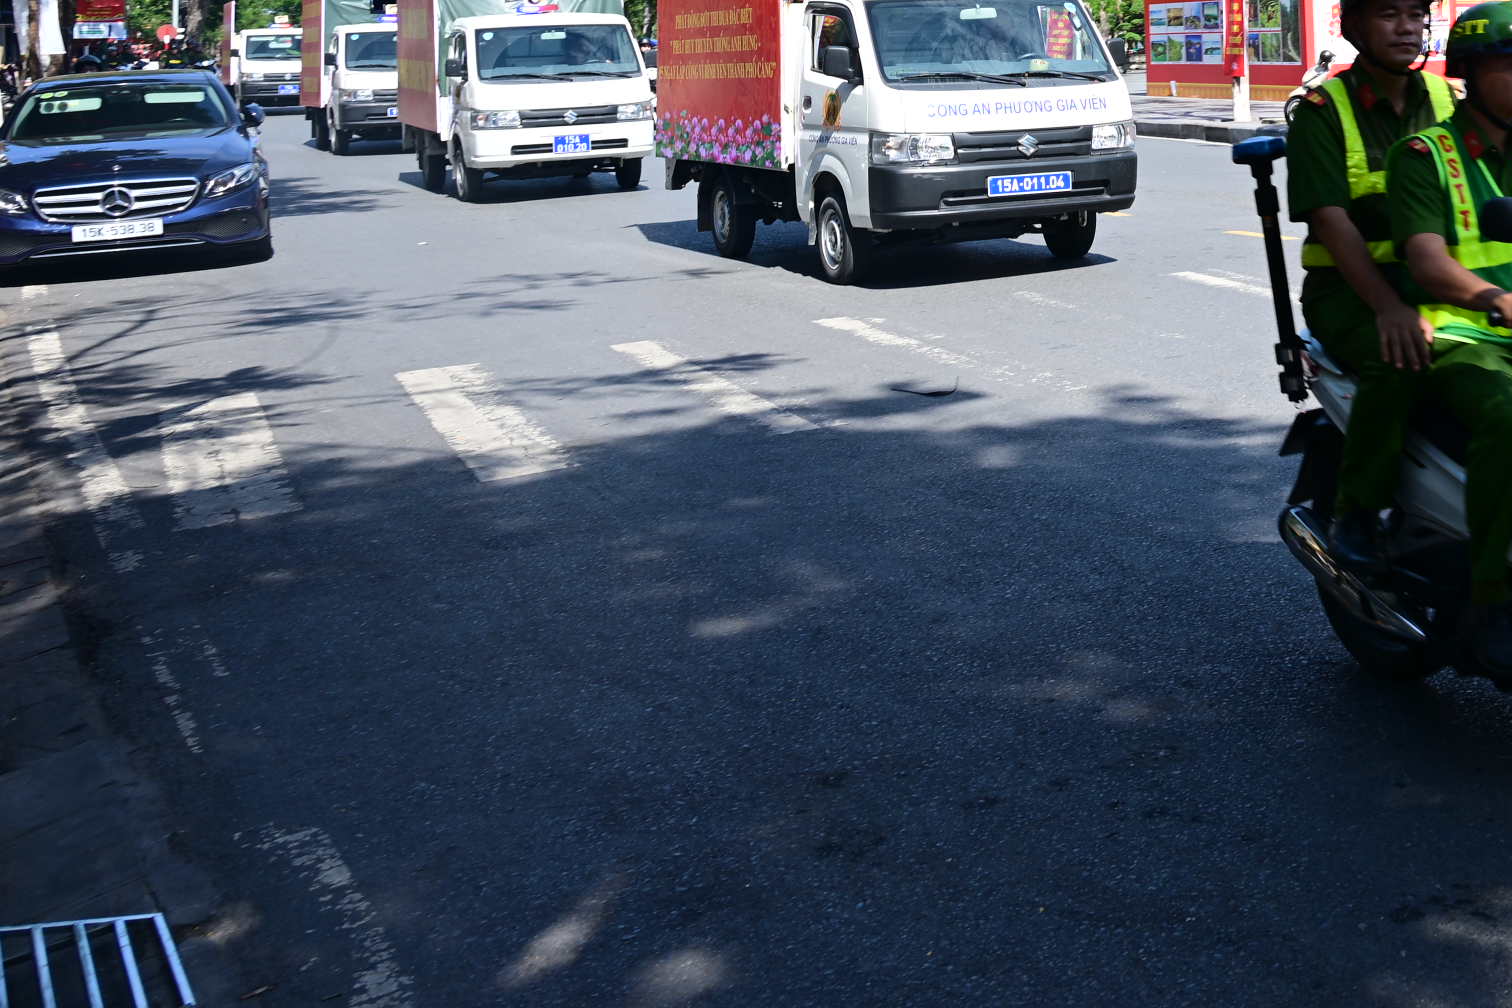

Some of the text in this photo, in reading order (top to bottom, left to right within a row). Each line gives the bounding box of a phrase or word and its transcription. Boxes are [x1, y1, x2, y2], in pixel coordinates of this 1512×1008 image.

[972, 102, 991, 115] AN
[1056, 98, 1079, 112] GIA
[997, 175, 1065, 192] 15A-011.04
